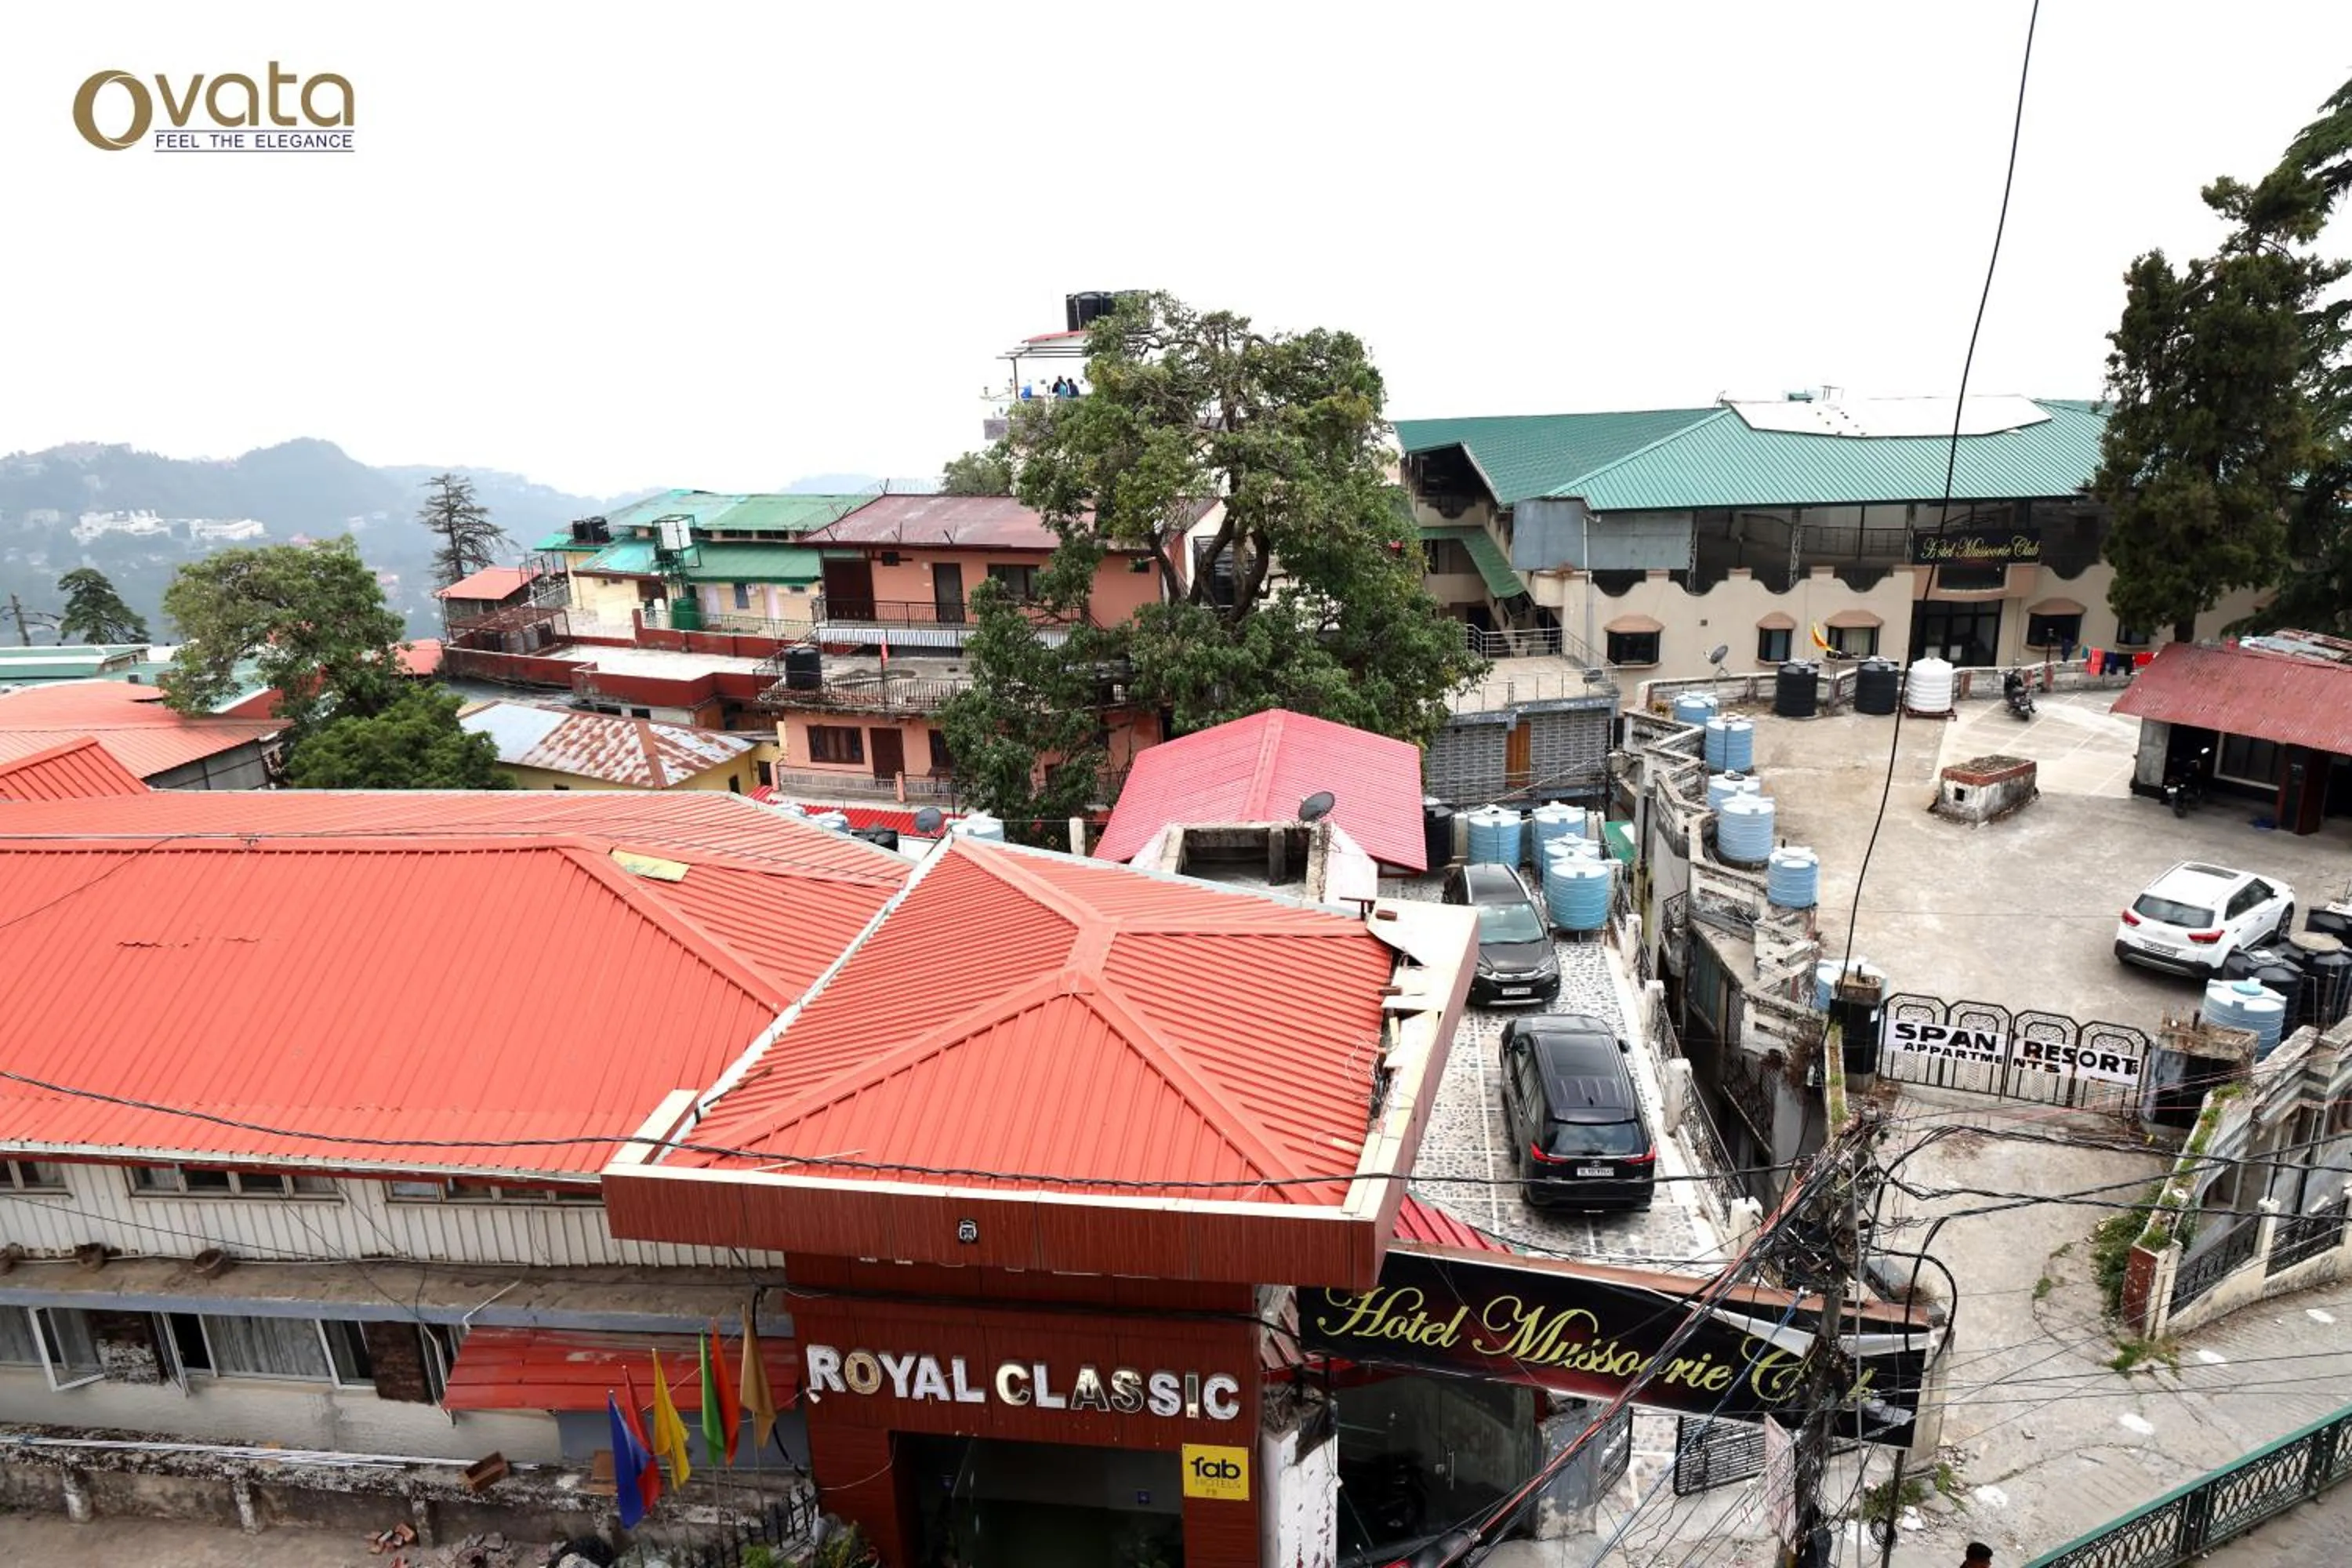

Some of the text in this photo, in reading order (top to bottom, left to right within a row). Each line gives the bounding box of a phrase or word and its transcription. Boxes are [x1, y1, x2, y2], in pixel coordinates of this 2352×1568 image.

[1895, 1022, 1997, 1051] SPAN
[1316, 1287, 1469, 1348] Hotel
[1740, 1336, 1875, 1403] Cb
[806, 1345, 1240, 1420] ROYAL CLASSIC
[1190, 1456, 1241, 1479] fab
